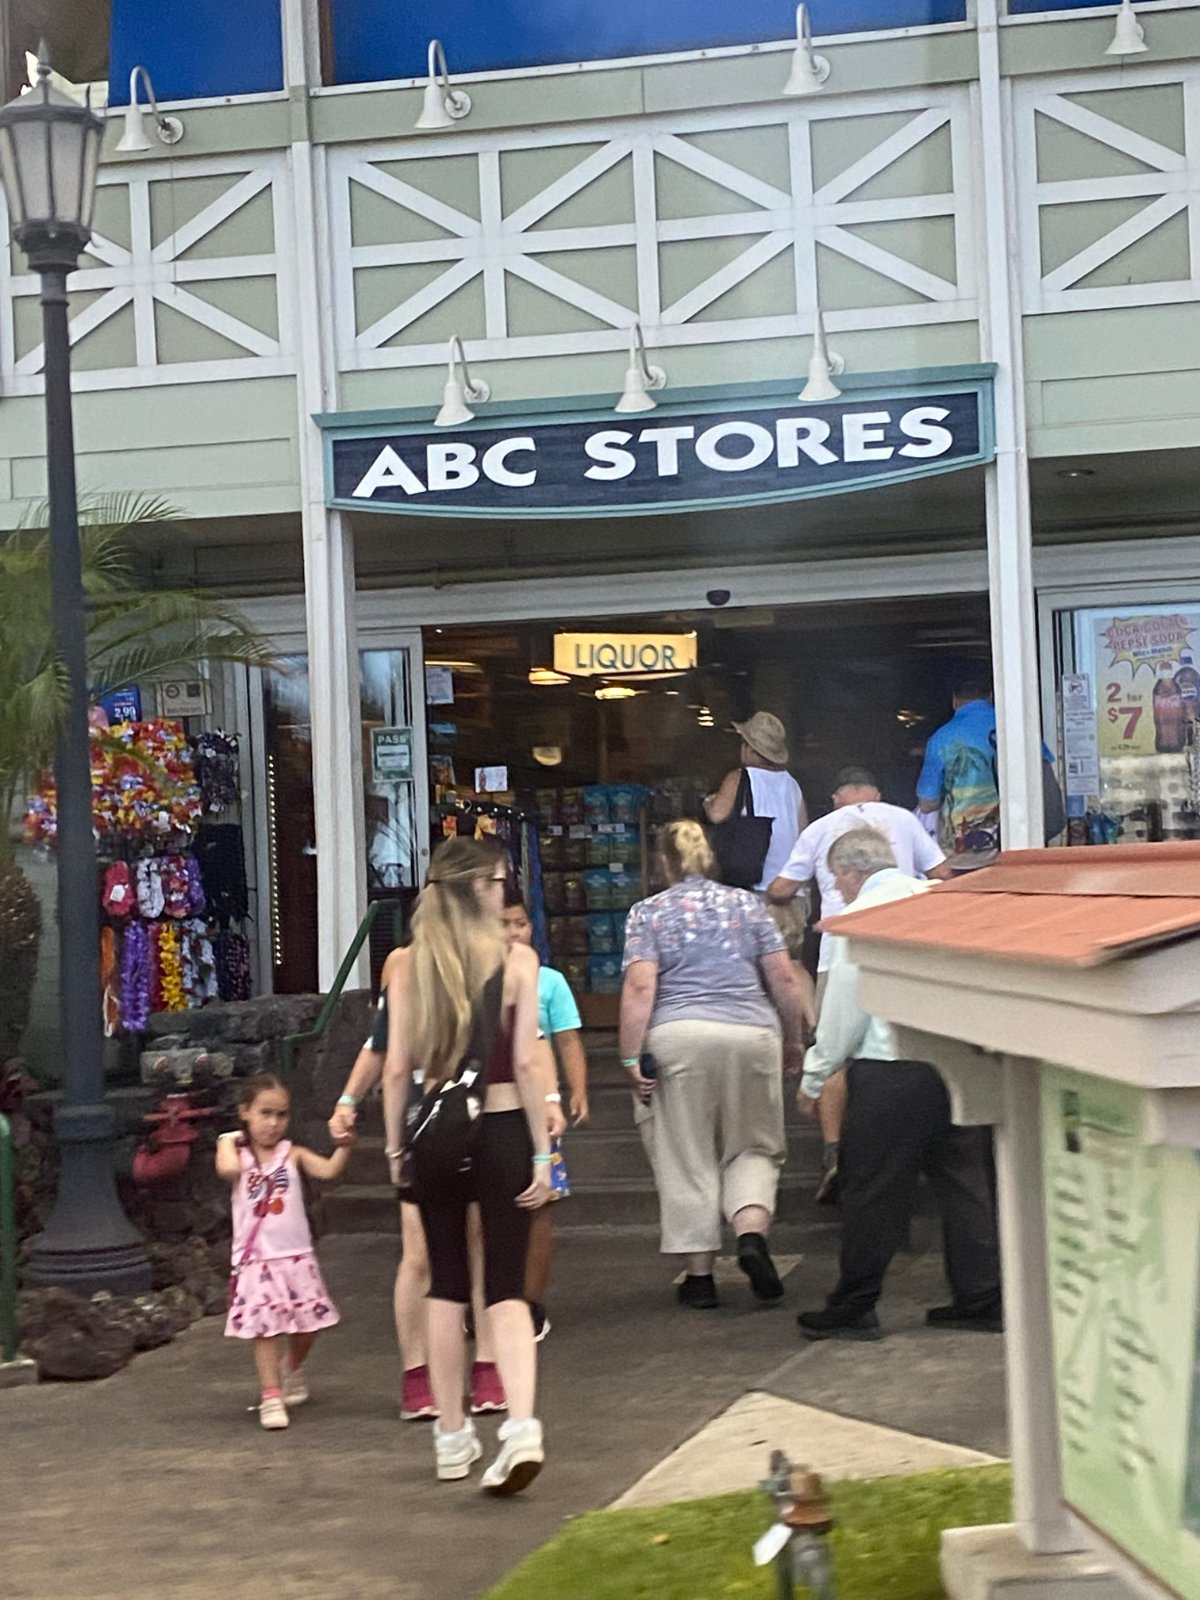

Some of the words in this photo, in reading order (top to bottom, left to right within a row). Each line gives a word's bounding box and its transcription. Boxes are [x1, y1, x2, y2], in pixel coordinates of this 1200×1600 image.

[352, 436, 538, 498] ABC
[583, 406, 953, 481] STORES
[575, 643, 677, 670] LIQUOR
[1106, 682, 1122, 703] 2
[1107, 706, 1143, 740] $7
[377, 735, 407, 744] PASS
